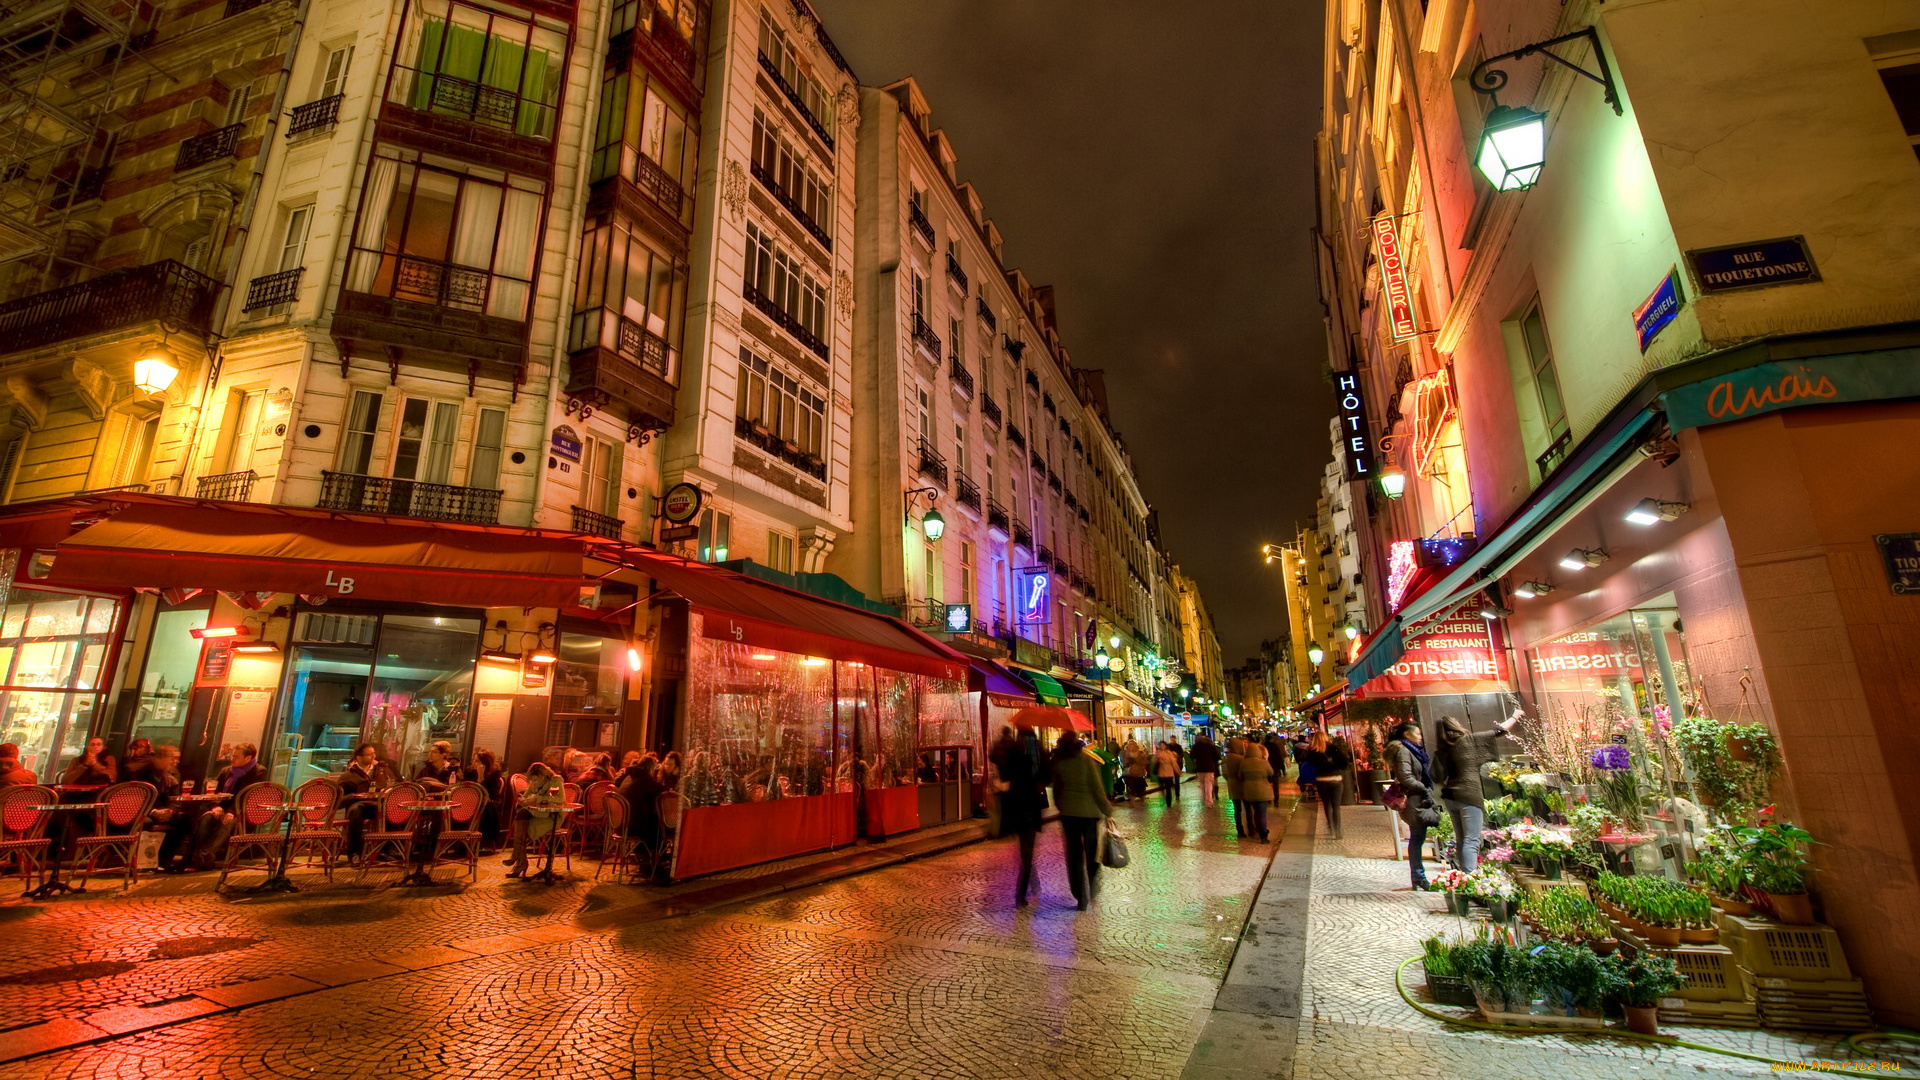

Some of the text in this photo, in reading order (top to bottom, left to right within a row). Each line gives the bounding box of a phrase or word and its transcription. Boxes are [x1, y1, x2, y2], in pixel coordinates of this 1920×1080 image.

[1733, 251, 1765, 265] RUE
[1377, 220, 1413, 334] BOUCHERIE
[1704, 261, 1809, 284] TIQUETONNE
[1340, 375, 1367, 473] HÔTEL
[561, 463, 570, 472] 41
[1894, 557, 1920, 569] TIQ
[325, 570, 355, 595] LB
[729, 619, 743, 641] LB
[1406, 623, 1486, 635] BOUCHERIE
[1403, 638, 1489, 650] ICE RESTAUANT
